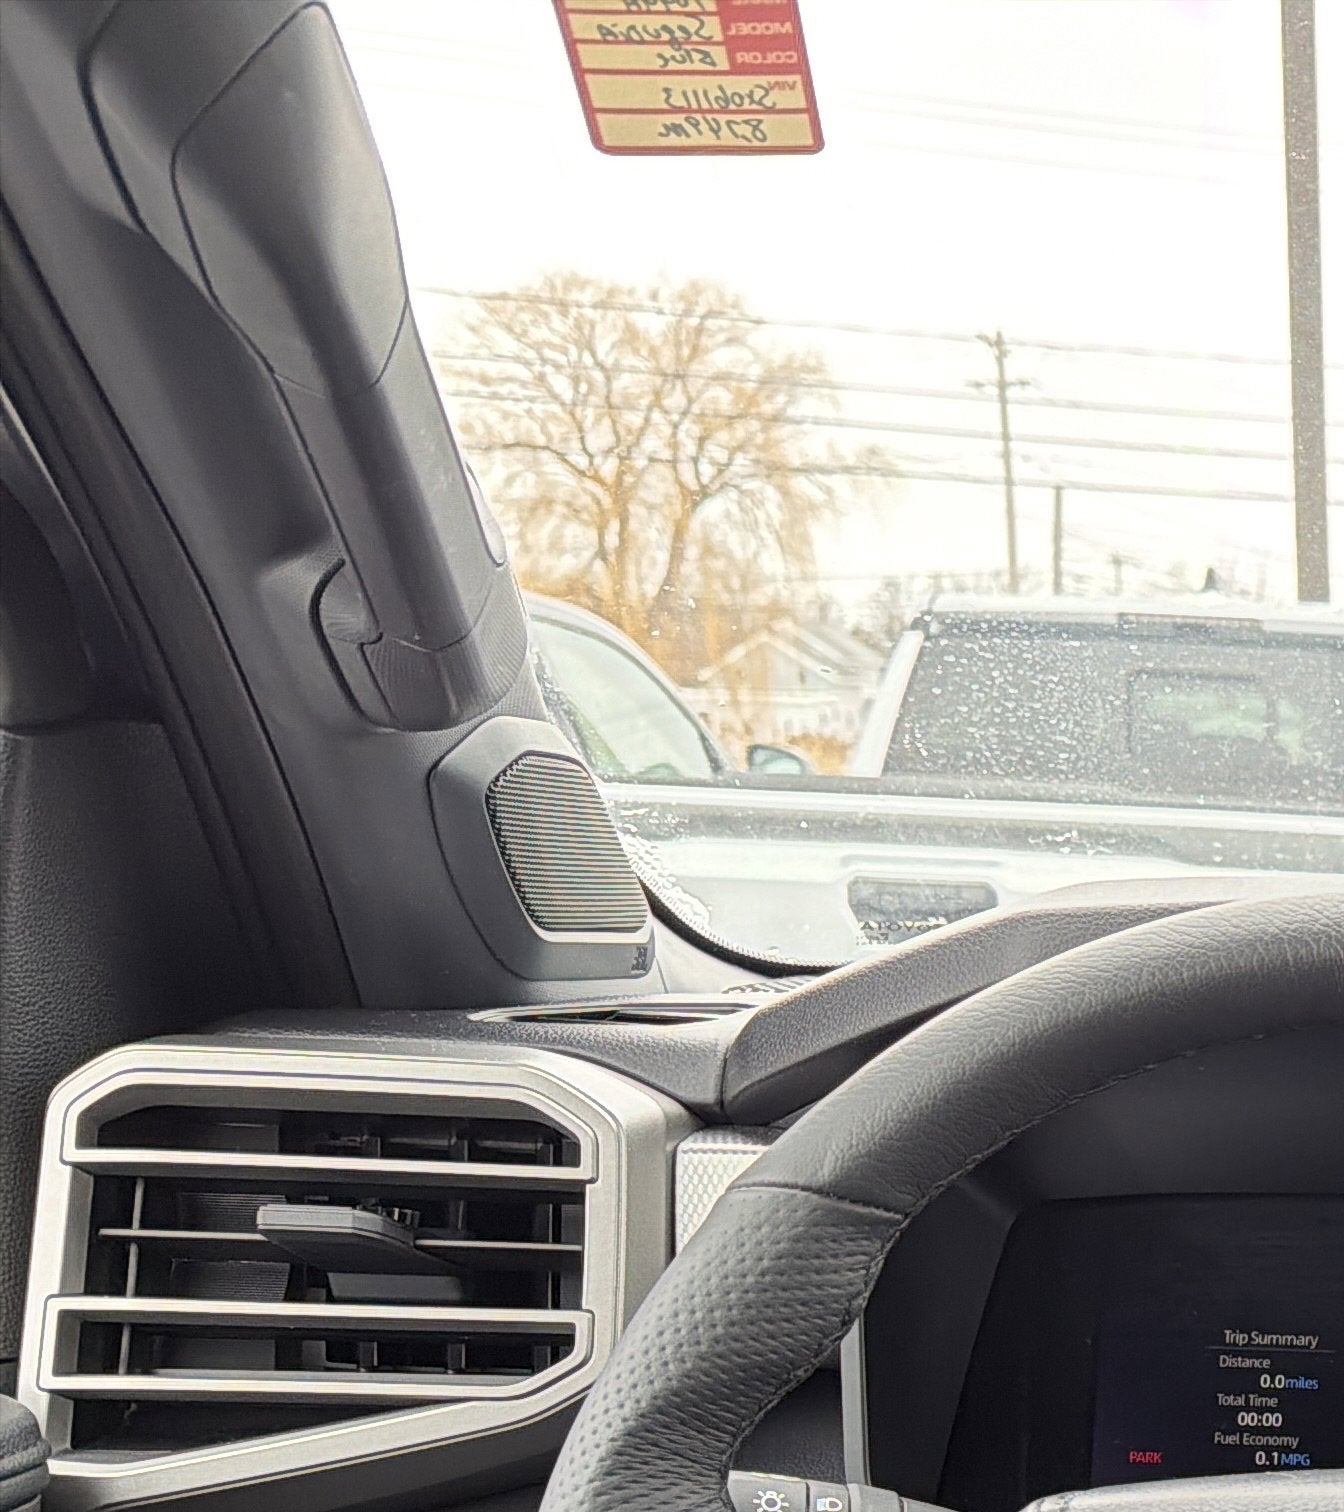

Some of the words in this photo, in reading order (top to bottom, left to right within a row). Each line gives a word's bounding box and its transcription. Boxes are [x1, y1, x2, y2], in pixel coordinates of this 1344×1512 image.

[1223, 1329, 1248, 1346] Trip
[1250, 1331, 1319, 1350] Summary
[1219, 1354, 1271, 1369] Distance
[1217, 1393, 1245, 1407] Total
[1249, 1393, 1278, 1408] Time
[1237, 1412, 1283, 1428] 00:00
[1214, 1431, 1240, 1446] Fuel
[1243, 1432, 1299, 1450] Economy
[1129, 1450, 1163, 1464] PARK
